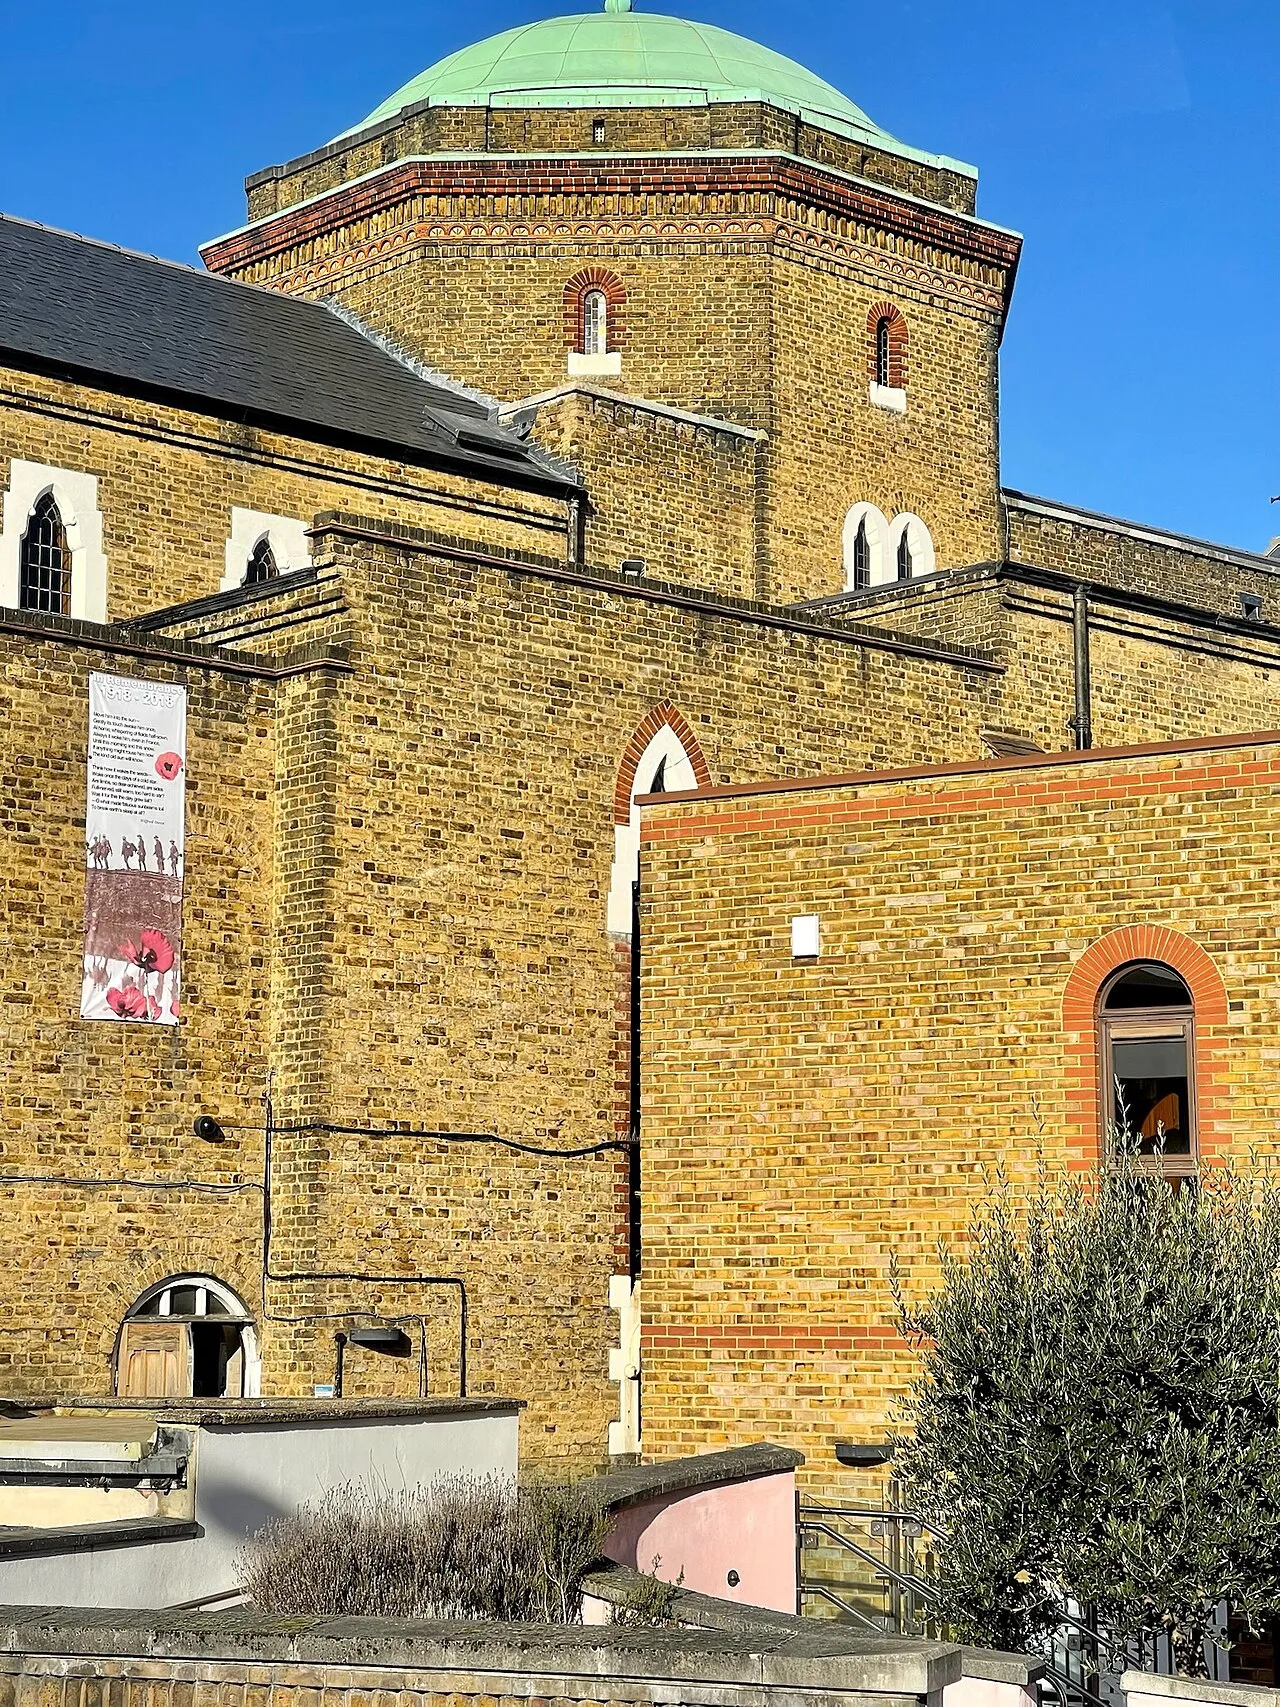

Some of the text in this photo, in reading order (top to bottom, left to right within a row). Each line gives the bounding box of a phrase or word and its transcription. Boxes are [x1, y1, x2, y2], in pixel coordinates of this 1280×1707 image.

[93, 674, 184, 695] In Remembrance
[100, 684, 132, 702] 1918
[143, 692, 174, 708] 2018
